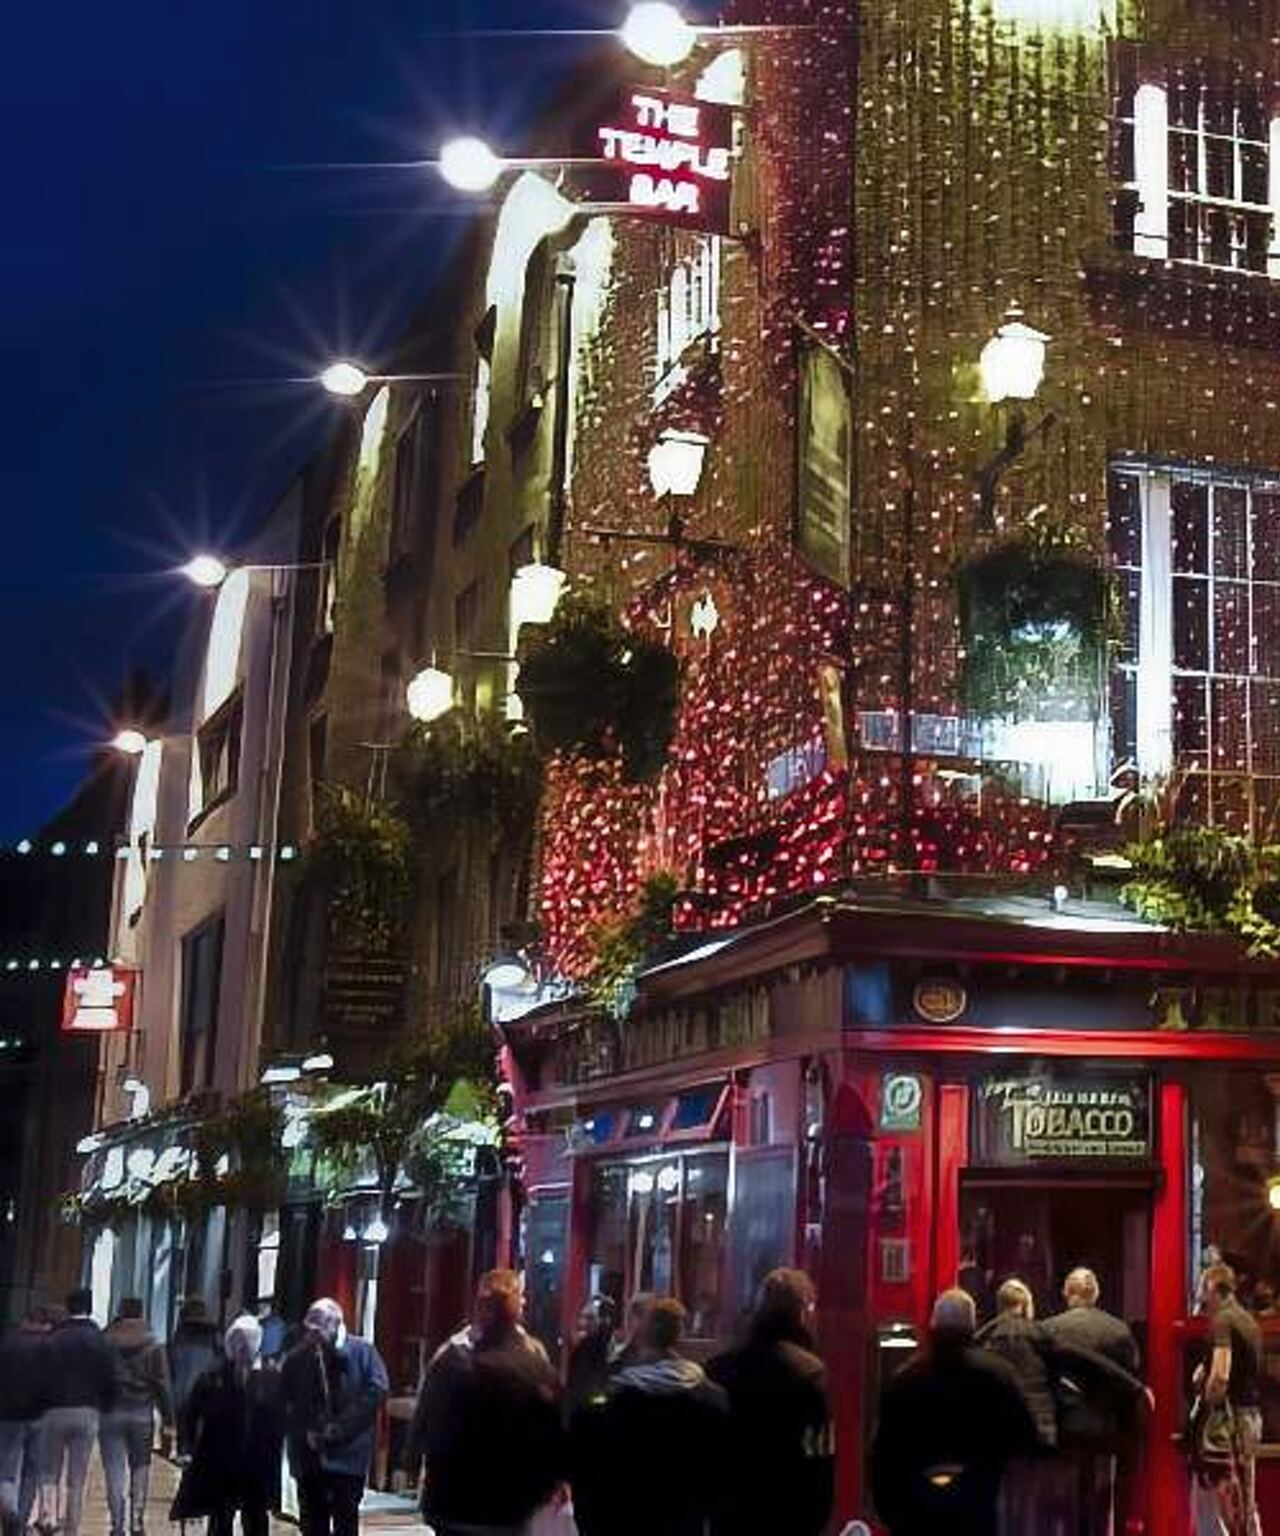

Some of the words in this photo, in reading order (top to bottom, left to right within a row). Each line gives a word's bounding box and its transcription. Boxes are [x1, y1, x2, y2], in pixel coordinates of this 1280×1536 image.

[630, 94, 700, 137] THE
[629, 172, 700, 213] BAR
[1012, 1097, 1134, 1149] TOBACCO
